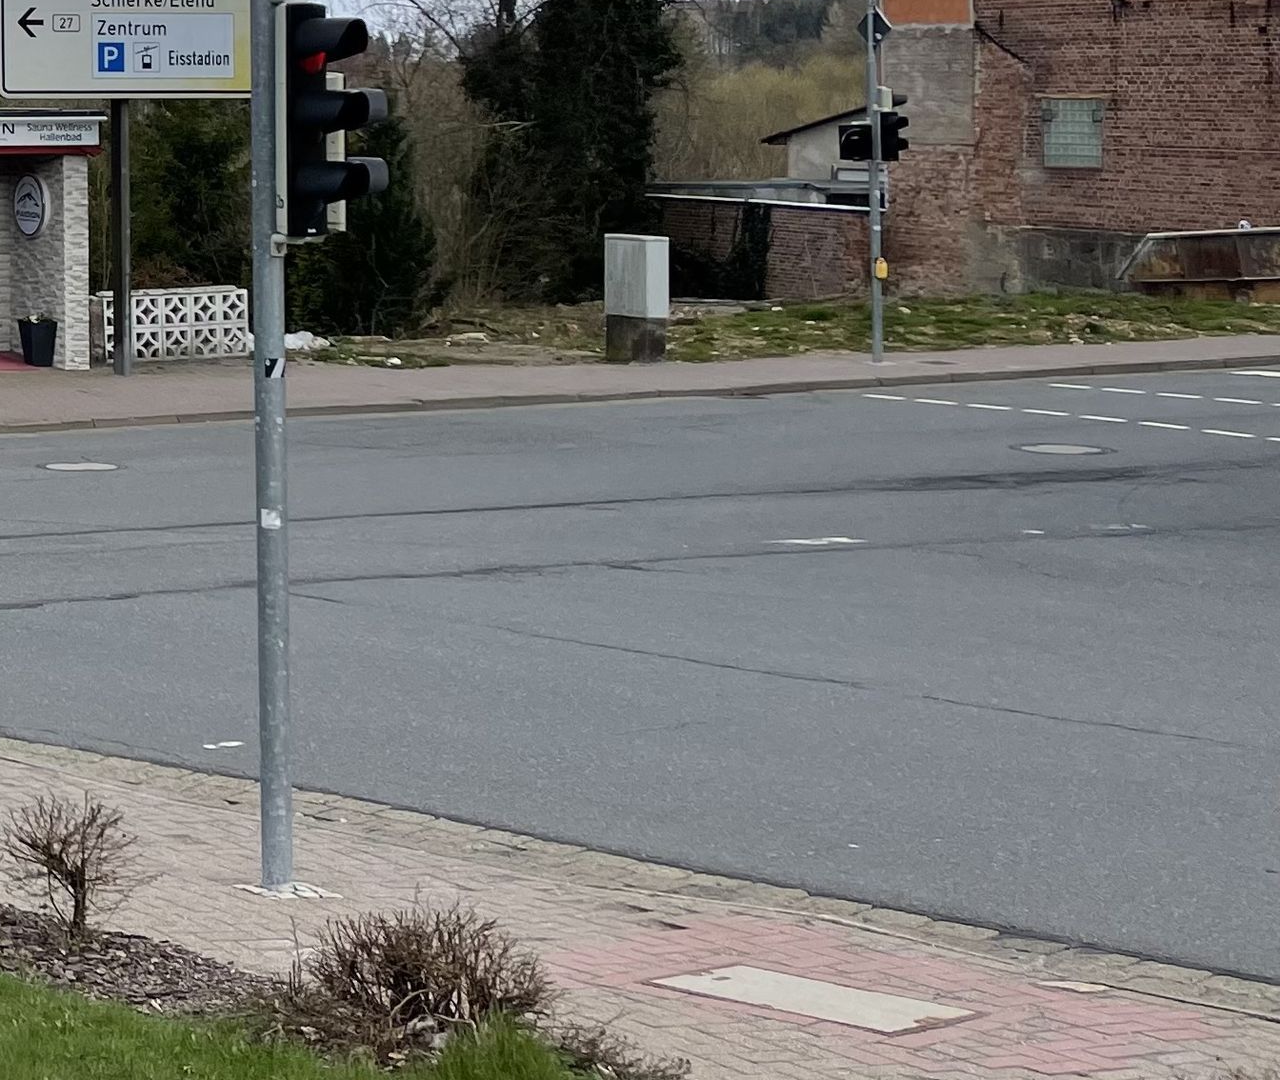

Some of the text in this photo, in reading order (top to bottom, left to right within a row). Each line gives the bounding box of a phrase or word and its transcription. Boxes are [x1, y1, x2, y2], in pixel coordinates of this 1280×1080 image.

[58, 18, 74, 29] 27
[97, 20, 167, 36] Zentrum
[103, 46, 119, 69] P
[168, 50, 230, 66] Eisstadion
[27, 123, 53, 132] Sauna
[40, 133, 82, 141] Hallenbad
